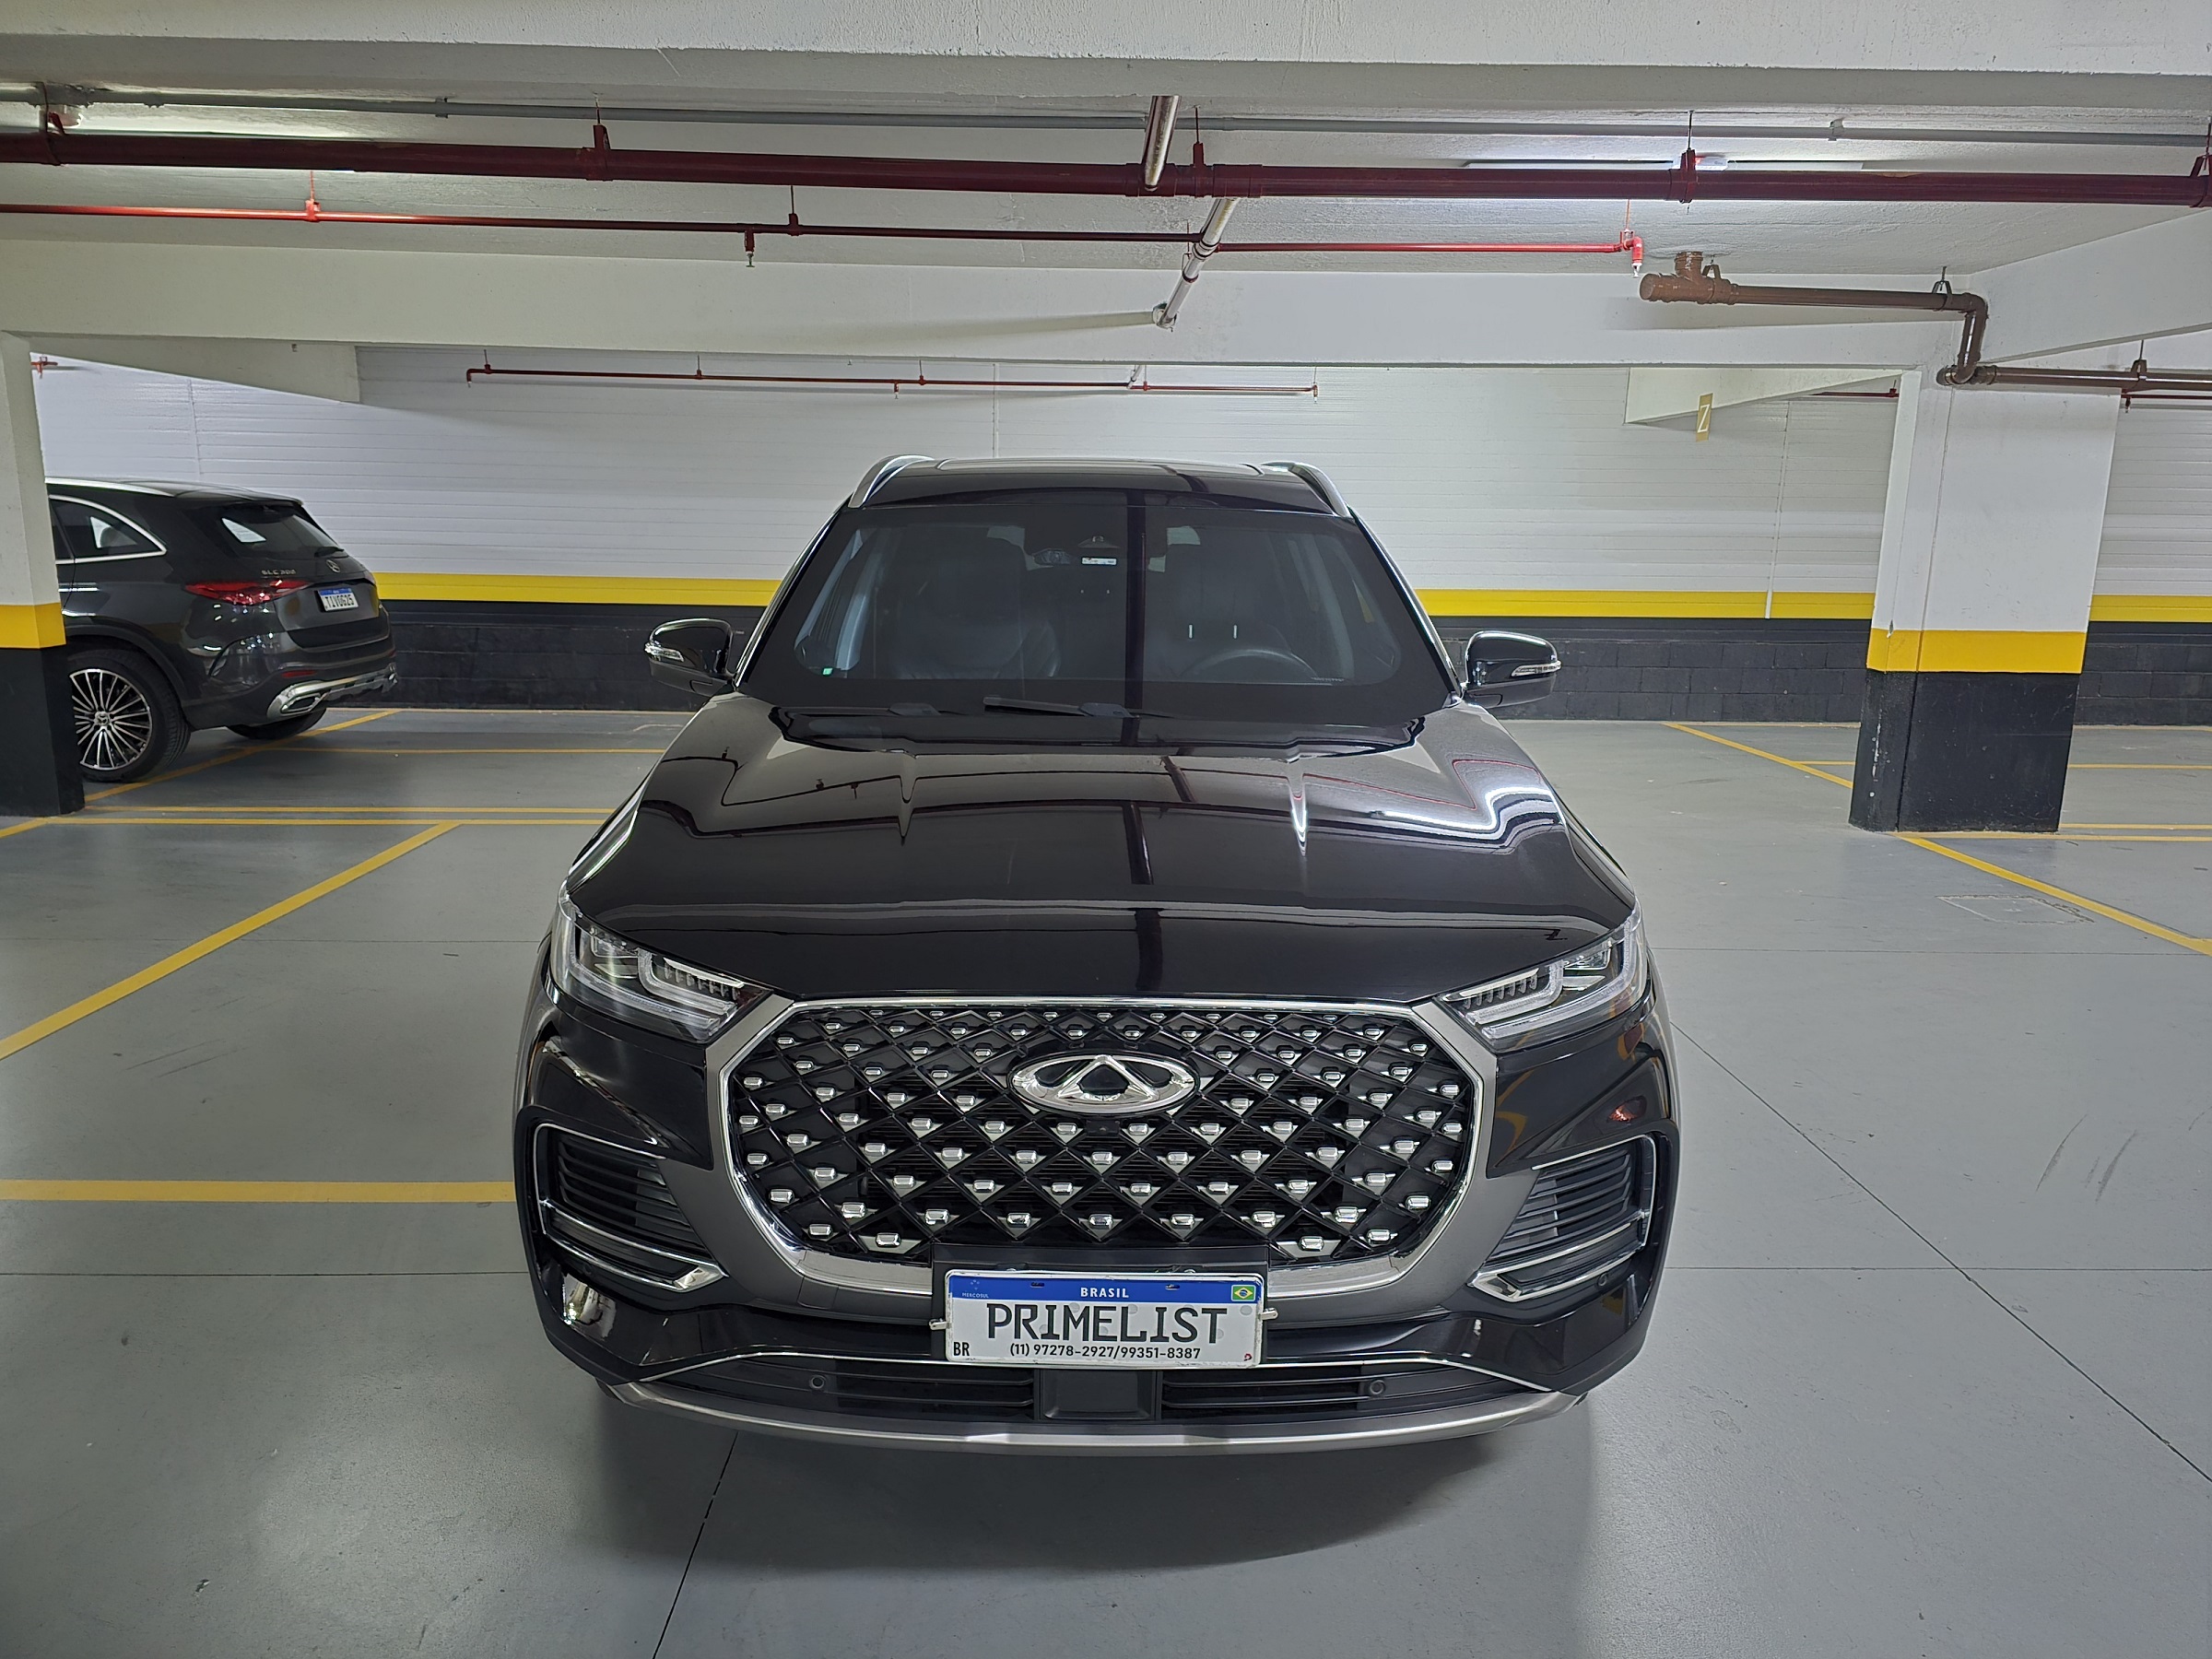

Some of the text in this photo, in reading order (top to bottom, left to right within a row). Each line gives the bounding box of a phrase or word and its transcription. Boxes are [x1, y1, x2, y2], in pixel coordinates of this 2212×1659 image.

[1080, 1287, 1129, 1298] BRASIL
[987, 1302, 1228, 1344] PRIMELIST
[953, 1342, 970, 1356] BR
[1010, 1343, 1201, 1359] (11) 97278-2927/99351-8387
